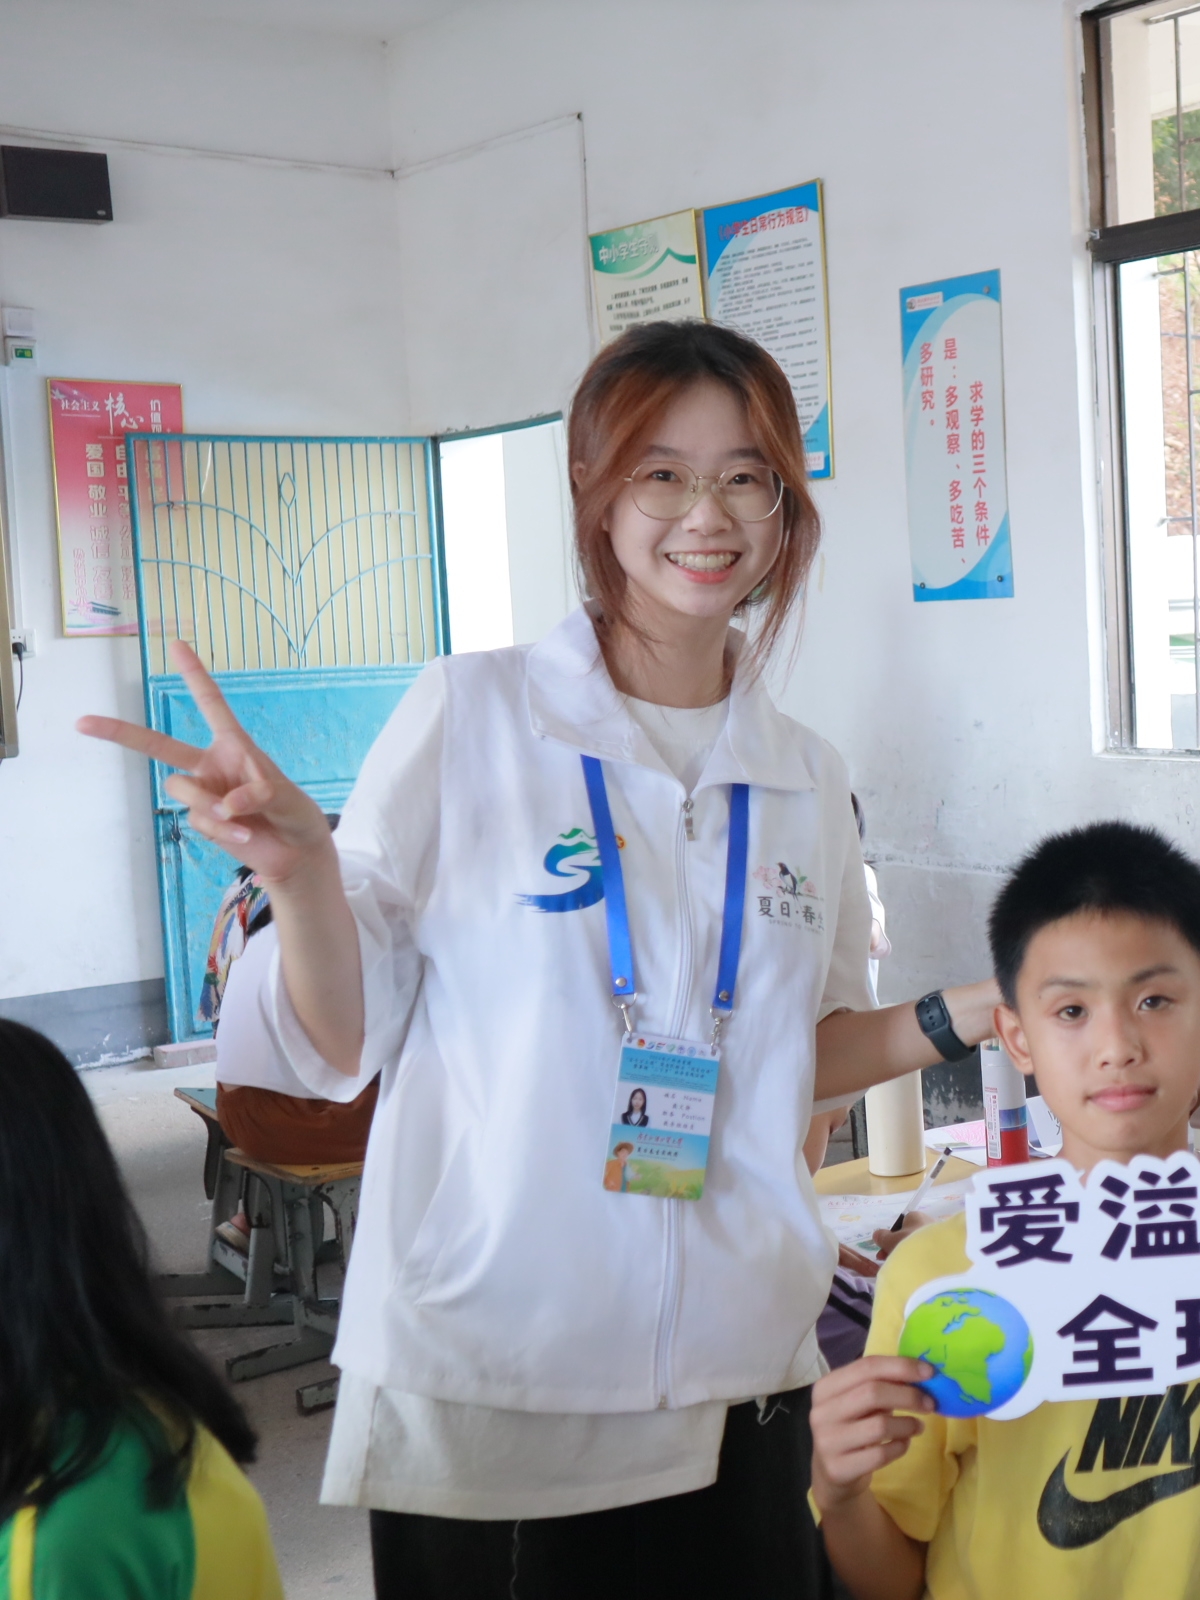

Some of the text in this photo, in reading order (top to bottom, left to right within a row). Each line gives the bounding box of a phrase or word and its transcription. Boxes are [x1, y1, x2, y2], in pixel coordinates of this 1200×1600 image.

[919, 342, 936, 427] 多研究。
[61, 398, 100, 412] 社会主义
[104, 392, 144, 435] 核心
[86, 443, 104, 478] 爱国
[969, 381, 991, 547] 求学的三个条件
[88, 485, 108, 518] 敬业
[90, 526, 110, 559] 诚信
